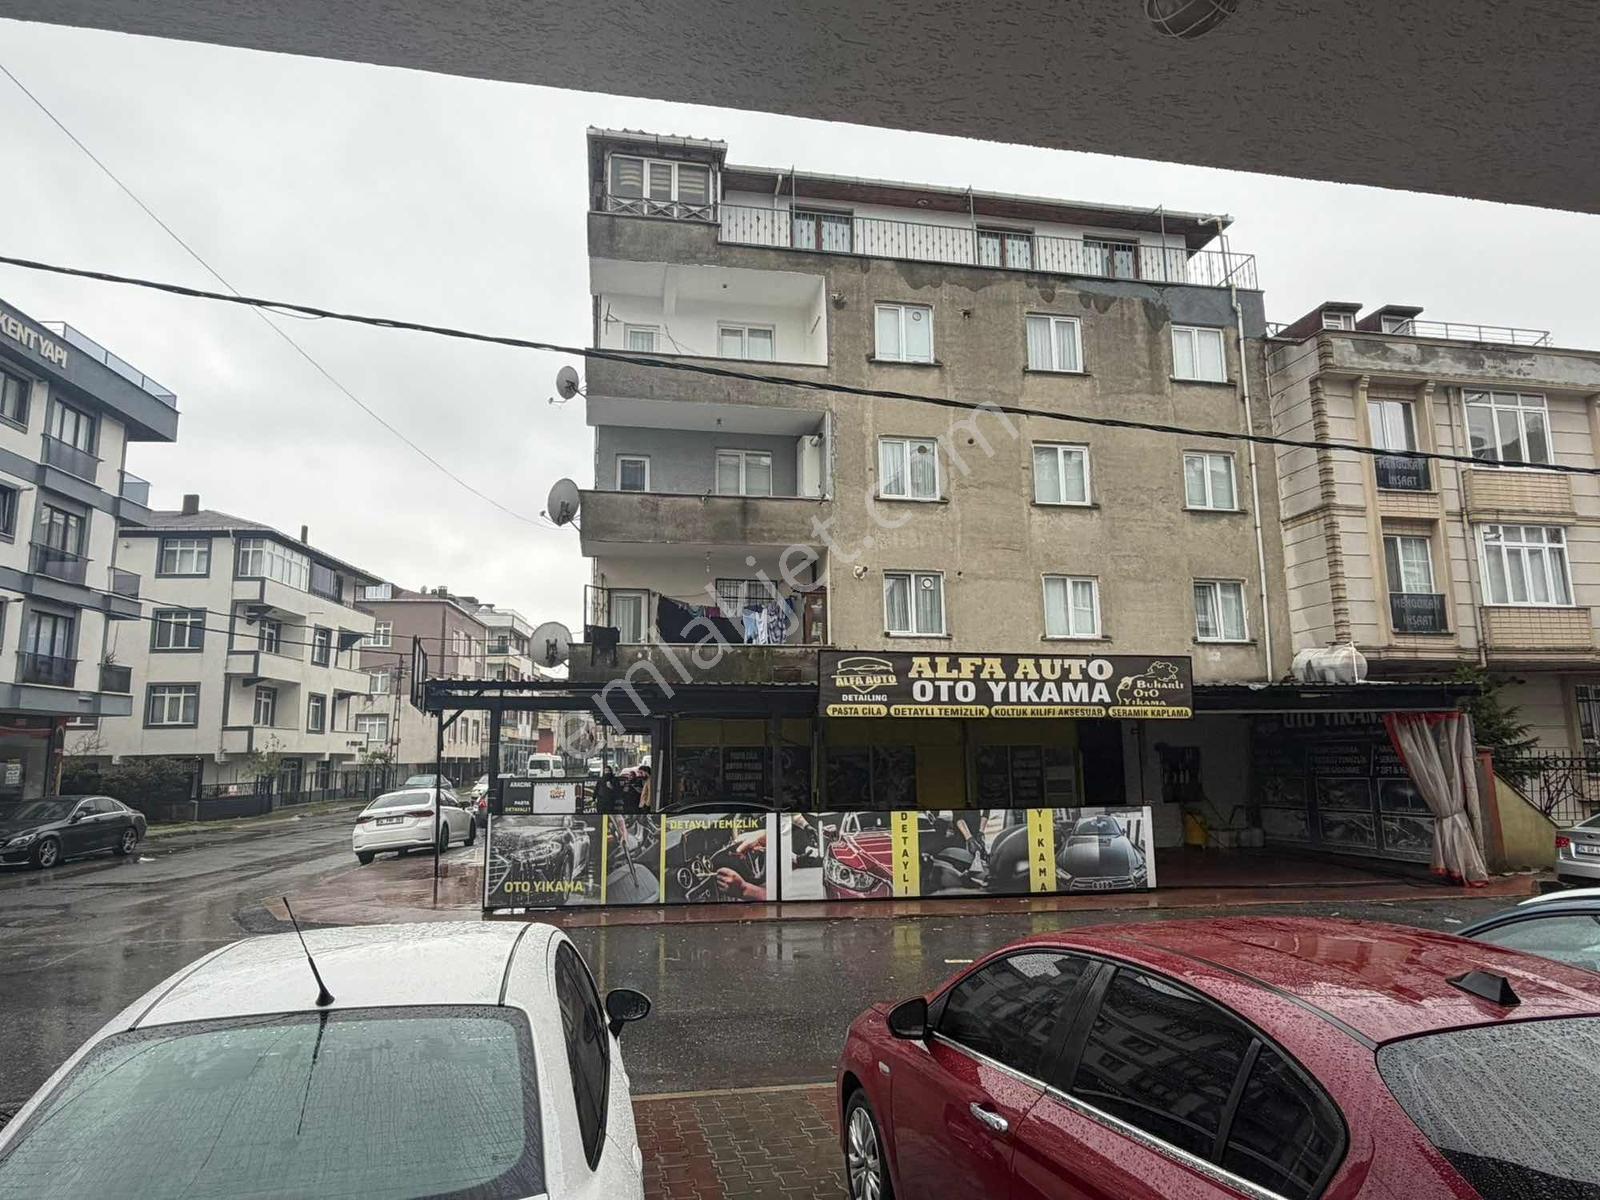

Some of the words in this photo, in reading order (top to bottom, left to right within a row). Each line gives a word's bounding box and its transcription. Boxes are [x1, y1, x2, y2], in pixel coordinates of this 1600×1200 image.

[38, 334, 68, 369] YAPI
[907, 656, 1007, 680] ALFA
[1013, 658, 1114, 681] AUTO
[835, 676, 865, 688] ALFA
[865, 674, 897, 686] AUTO
[841, 693, 888, 702] DETAILING
[912, 680, 976, 703] OTO
[986, 681, 1112, 703] YIKAMA
[831, 706, 859, 716] PASTA
[861, 705, 881, 716] CİLA
[893, 707, 935, 717] DETAYLI
[938, 706, 985, 717] TEMİZLİK
[994, 708, 1028, 718] KOLTUK
[1058, 708, 1103, 718] AKSESUAR
[1150, 709, 1189, 718] KAPLAMA
[670, 819, 711, 830] DETAYLI
[713, 816, 759, 829] TEMİZLİK
[900, 812, 910, 895] DETAYLI
[1036, 809, 1048, 892] YIKAMA
[503, 881, 531, 893] OTO
[533, 880, 584, 893] YIKAMA
